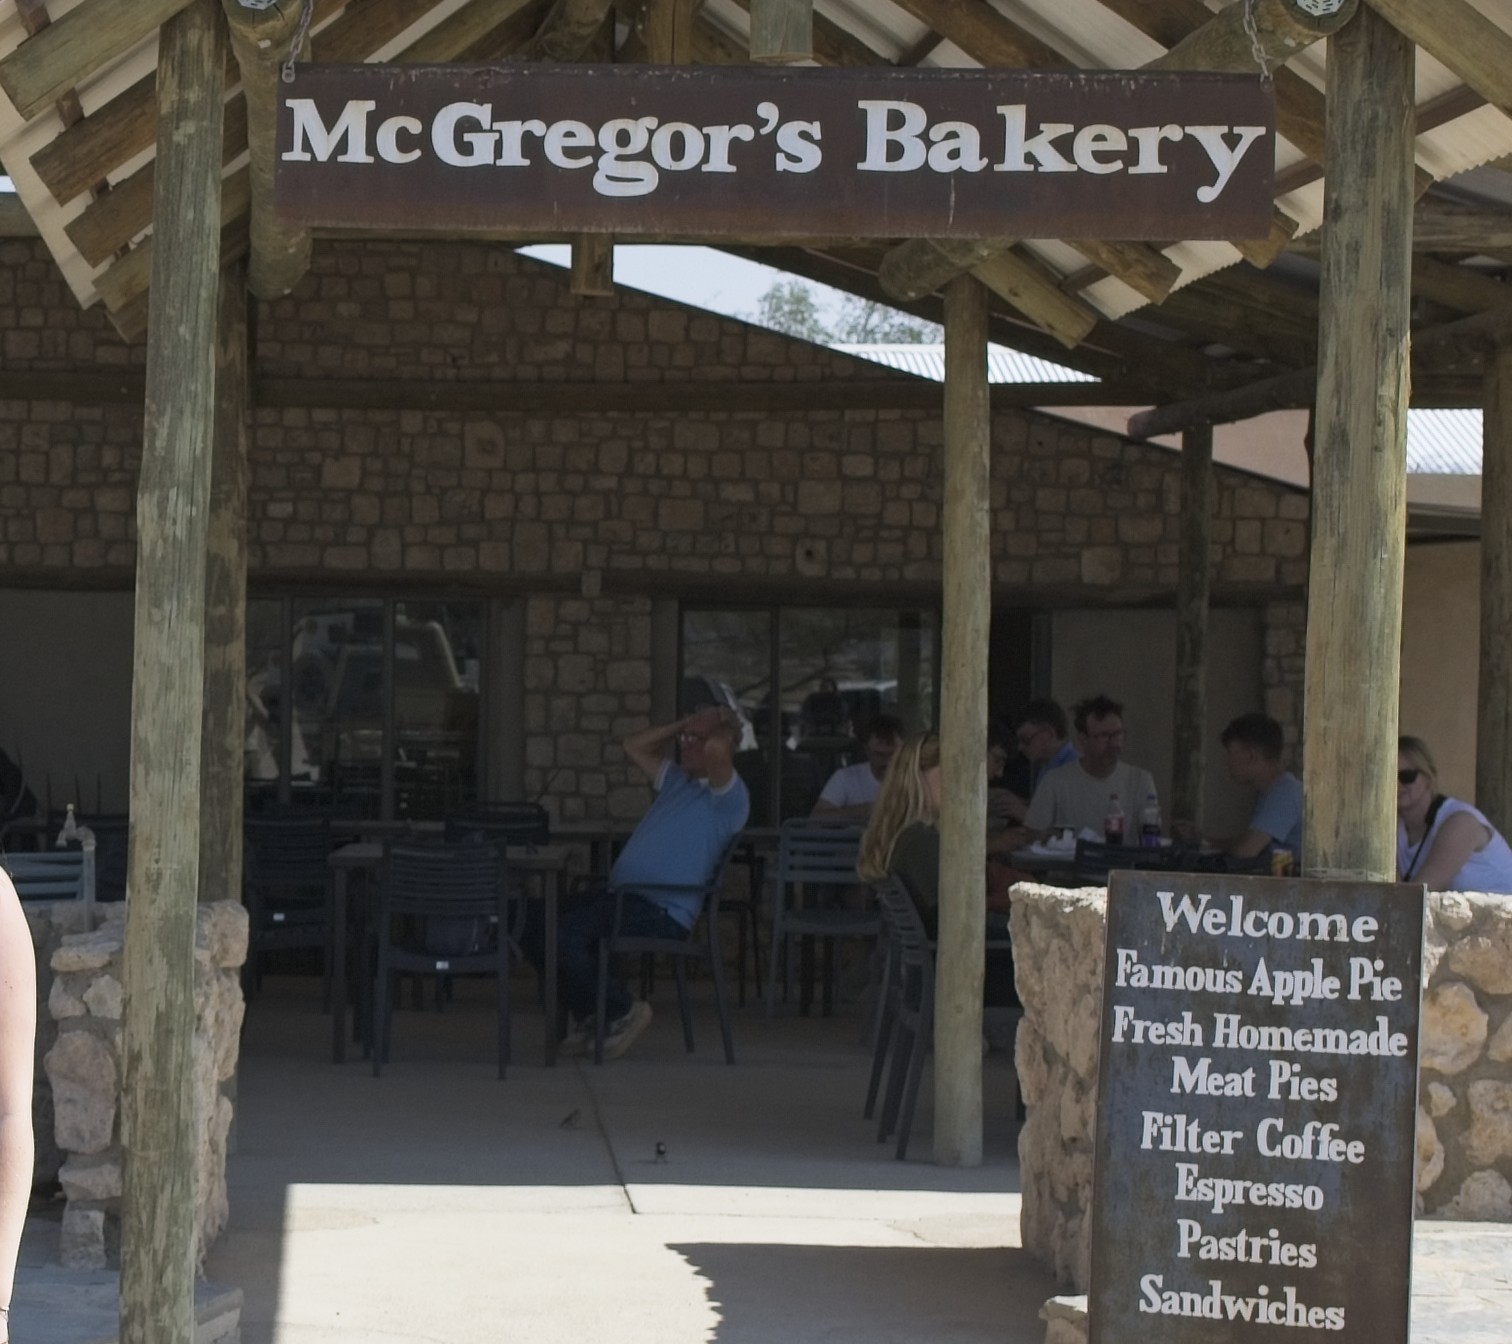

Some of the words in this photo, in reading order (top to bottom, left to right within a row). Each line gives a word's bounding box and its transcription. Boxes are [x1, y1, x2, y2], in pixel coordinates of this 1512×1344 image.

[280, 97, 823, 197] McGregor's
[856, 99, 1267, 203] Bakery
[1156, 891, 1379, 943] Welcome
[1114, 948, 1243, 994] Famous
[1247, 956, 1341, 1006] Apple
[1347, 956, 1403, 1002] Pie
[1111, 1005, 1203, 1048] Fresh
[1212, 1013, 1408, 1058] Homemade
[1169, 1056, 1256, 1098] Meat
[1267, 1060, 1338, 1102] Pies
[1140, 1110, 1244, 1155] Filter
[1256, 1116, 1366, 1164] Coffee
[1174, 1163, 1324, 1214] Espresso
[1176, 1218, 1318, 1268] Pastries
[1138, 1272, 1346, 1330] Sandwiches
